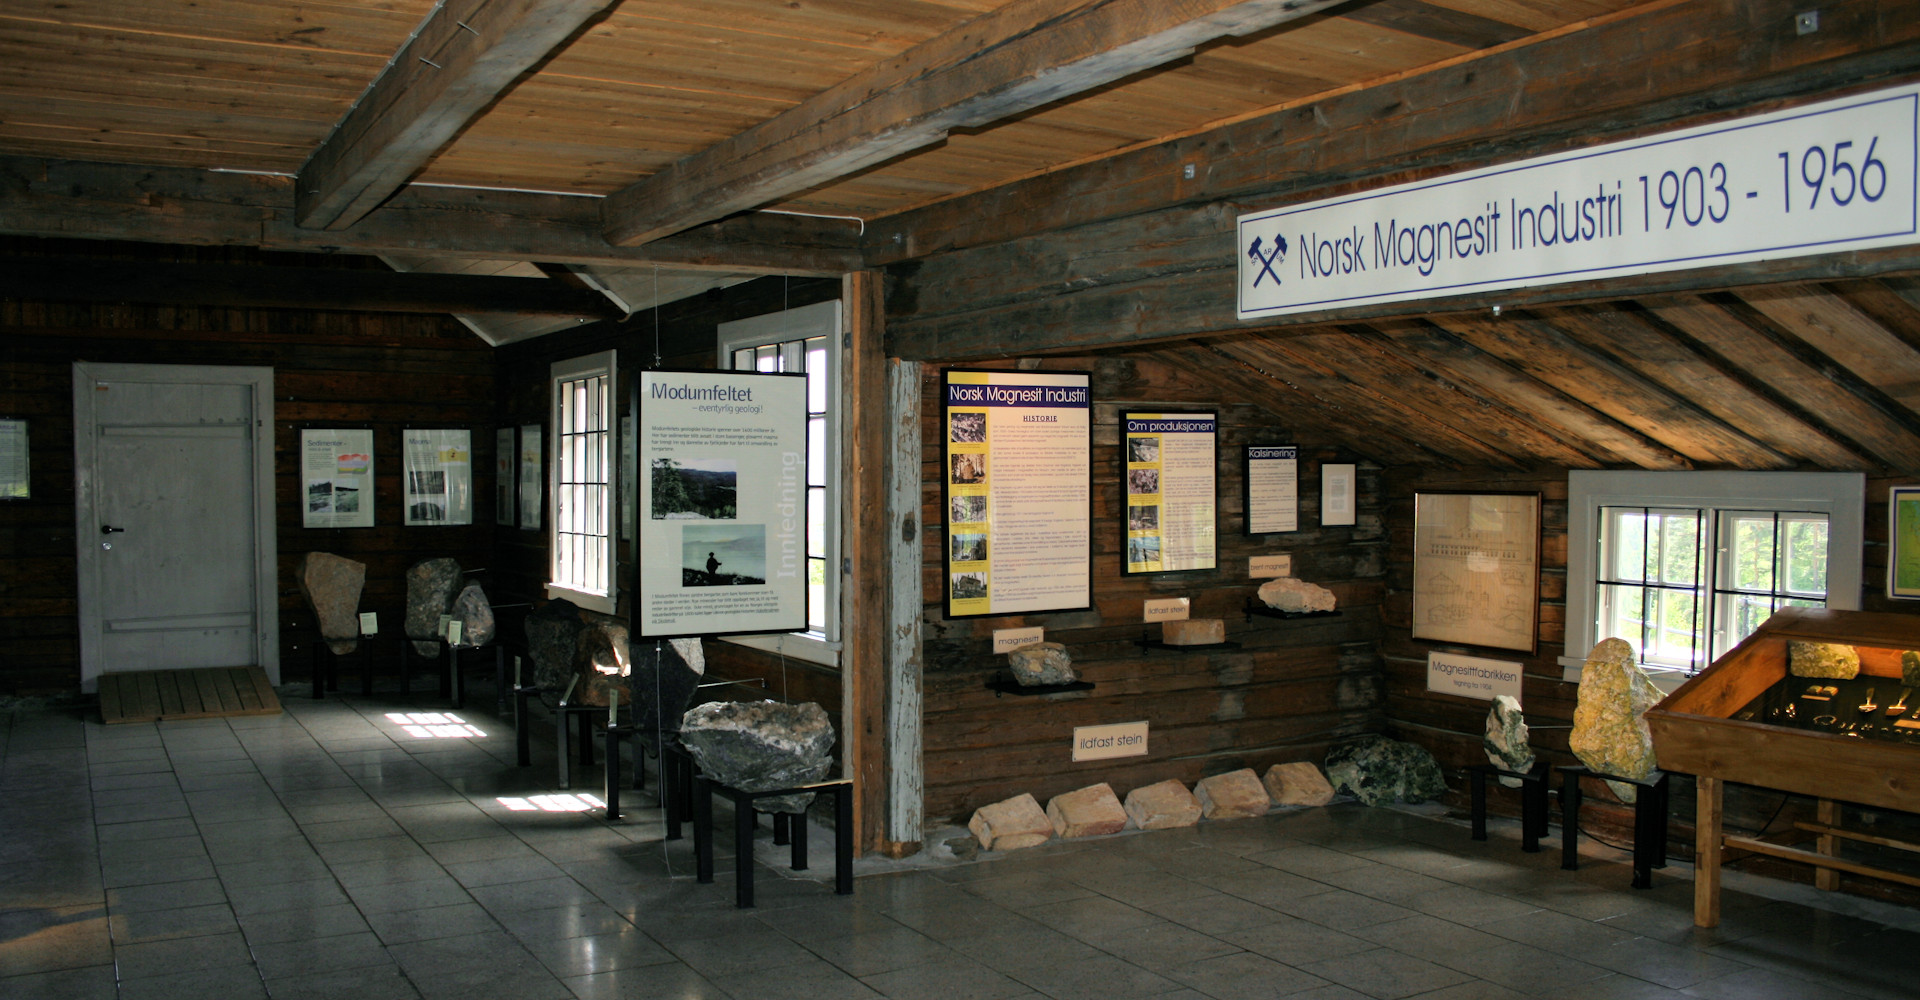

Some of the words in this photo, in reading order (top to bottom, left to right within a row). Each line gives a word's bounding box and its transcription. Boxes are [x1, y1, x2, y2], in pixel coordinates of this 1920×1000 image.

[1300, 225, 1366, 280] Norsk
[1374, 201, 1501, 277] Magnesit
[1511, 180, 1622, 250] Industri
[1638, 162, 1730, 233] 1903
[1746, 190, 1758, 200] -
[1778, 136, 1887, 214] 1956
[1276, 253, 1285, 265] UM
[651, 382, 753, 402] Modumfeltet
[950, 386, 984, 401] Norsk
[987, 387, 1042, 405] Magnesit
[1046, 388, 1086, 403] Industri
[698, 404, 734, 415] eventyrlig
[734, 405, 764, 415] geologi!
[1023, 415, 1058, 423] HISTORIE
[1128, 421, 1147, 431] Om
[1150, 421, 1214, 433] produksjonen
[1248, 448, 1296, 459] Kalsinering
[777, 451, 805, 579] Innledning
[1147, 606, 1168, 615] ildfast
[1169, 605, 1186, 614] stein
[998, 634, 1041, 646] magnesitt
[1432, 660, 1517, 682] Magnesittfabrikken
[1080, 736, 1115, 750] ildfast
[1117, 733, 1143, 747] stein
